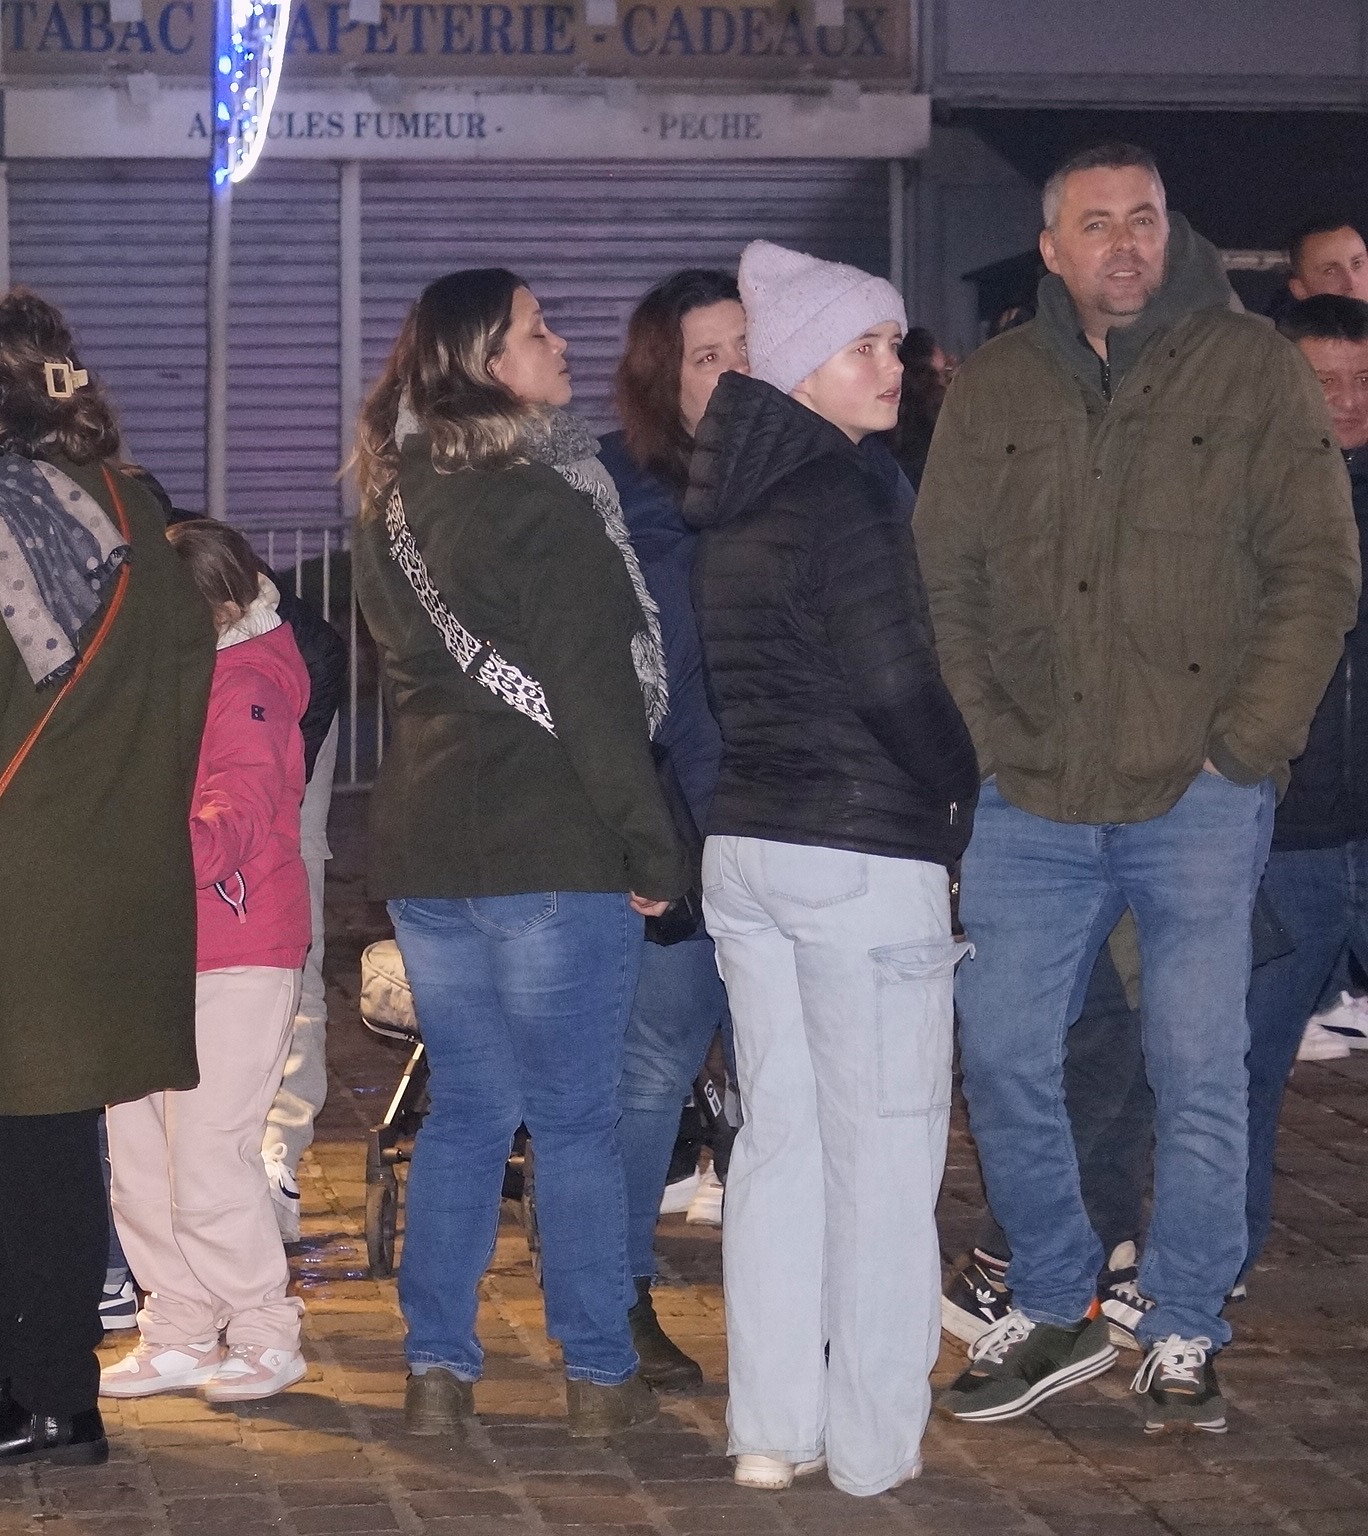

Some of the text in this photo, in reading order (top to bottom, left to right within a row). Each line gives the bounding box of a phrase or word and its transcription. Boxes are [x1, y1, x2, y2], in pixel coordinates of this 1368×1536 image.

[2, 3, 194, 53] TABAC
[623, 4, 886, 56] CADEAUX
[353, 111, 486, 139] FUMEUR
[659, 112, 762, 140] PECHE
